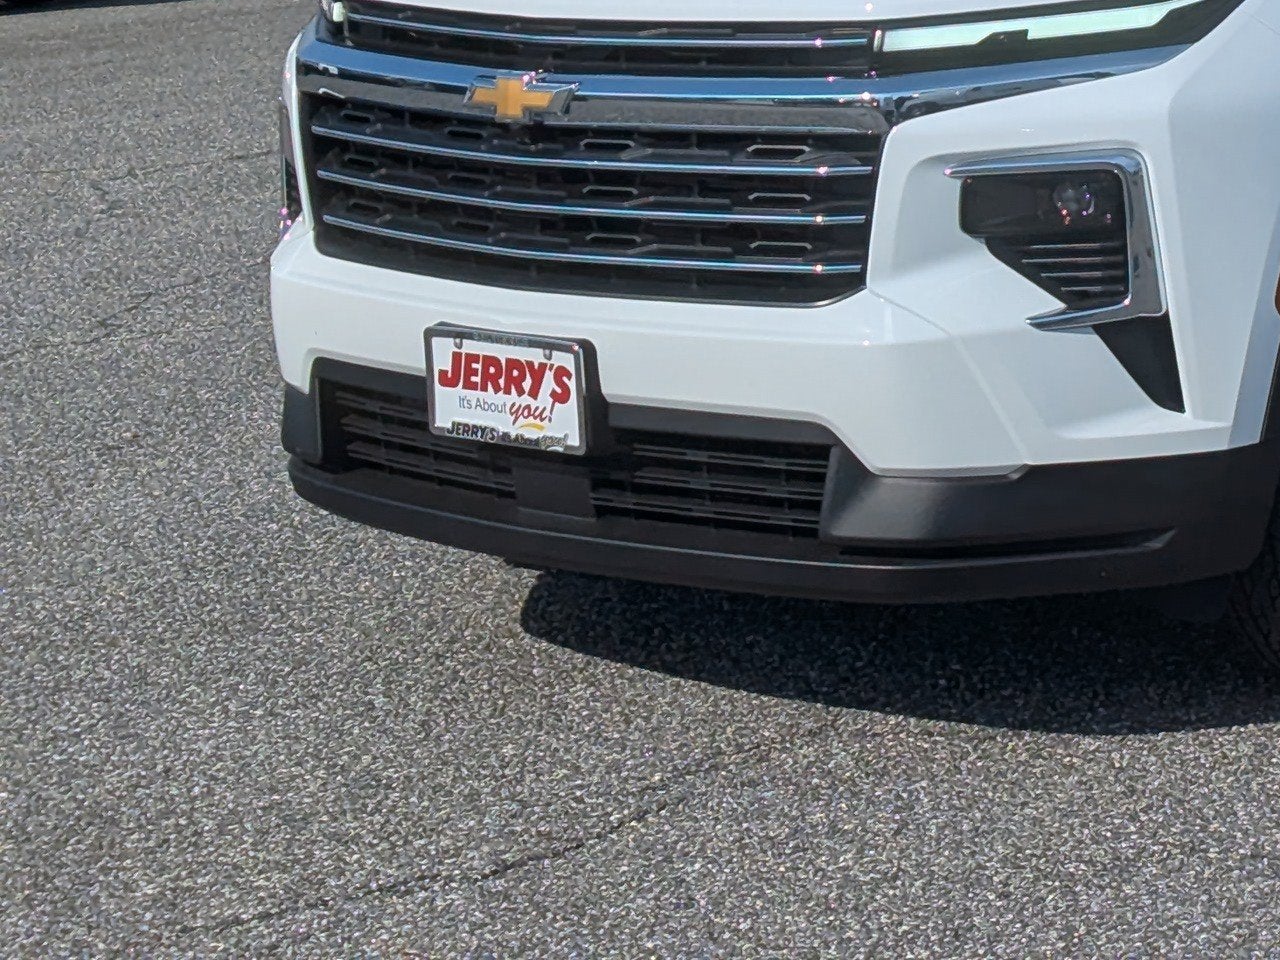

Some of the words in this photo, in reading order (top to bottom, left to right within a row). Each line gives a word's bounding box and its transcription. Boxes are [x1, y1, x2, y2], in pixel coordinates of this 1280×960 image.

[438, 351, 572, 405] JERRY'S
[458, 395, 472, 410] It's
[475, 397, 507, 415] About
[508, 400, 557, 426] you!
